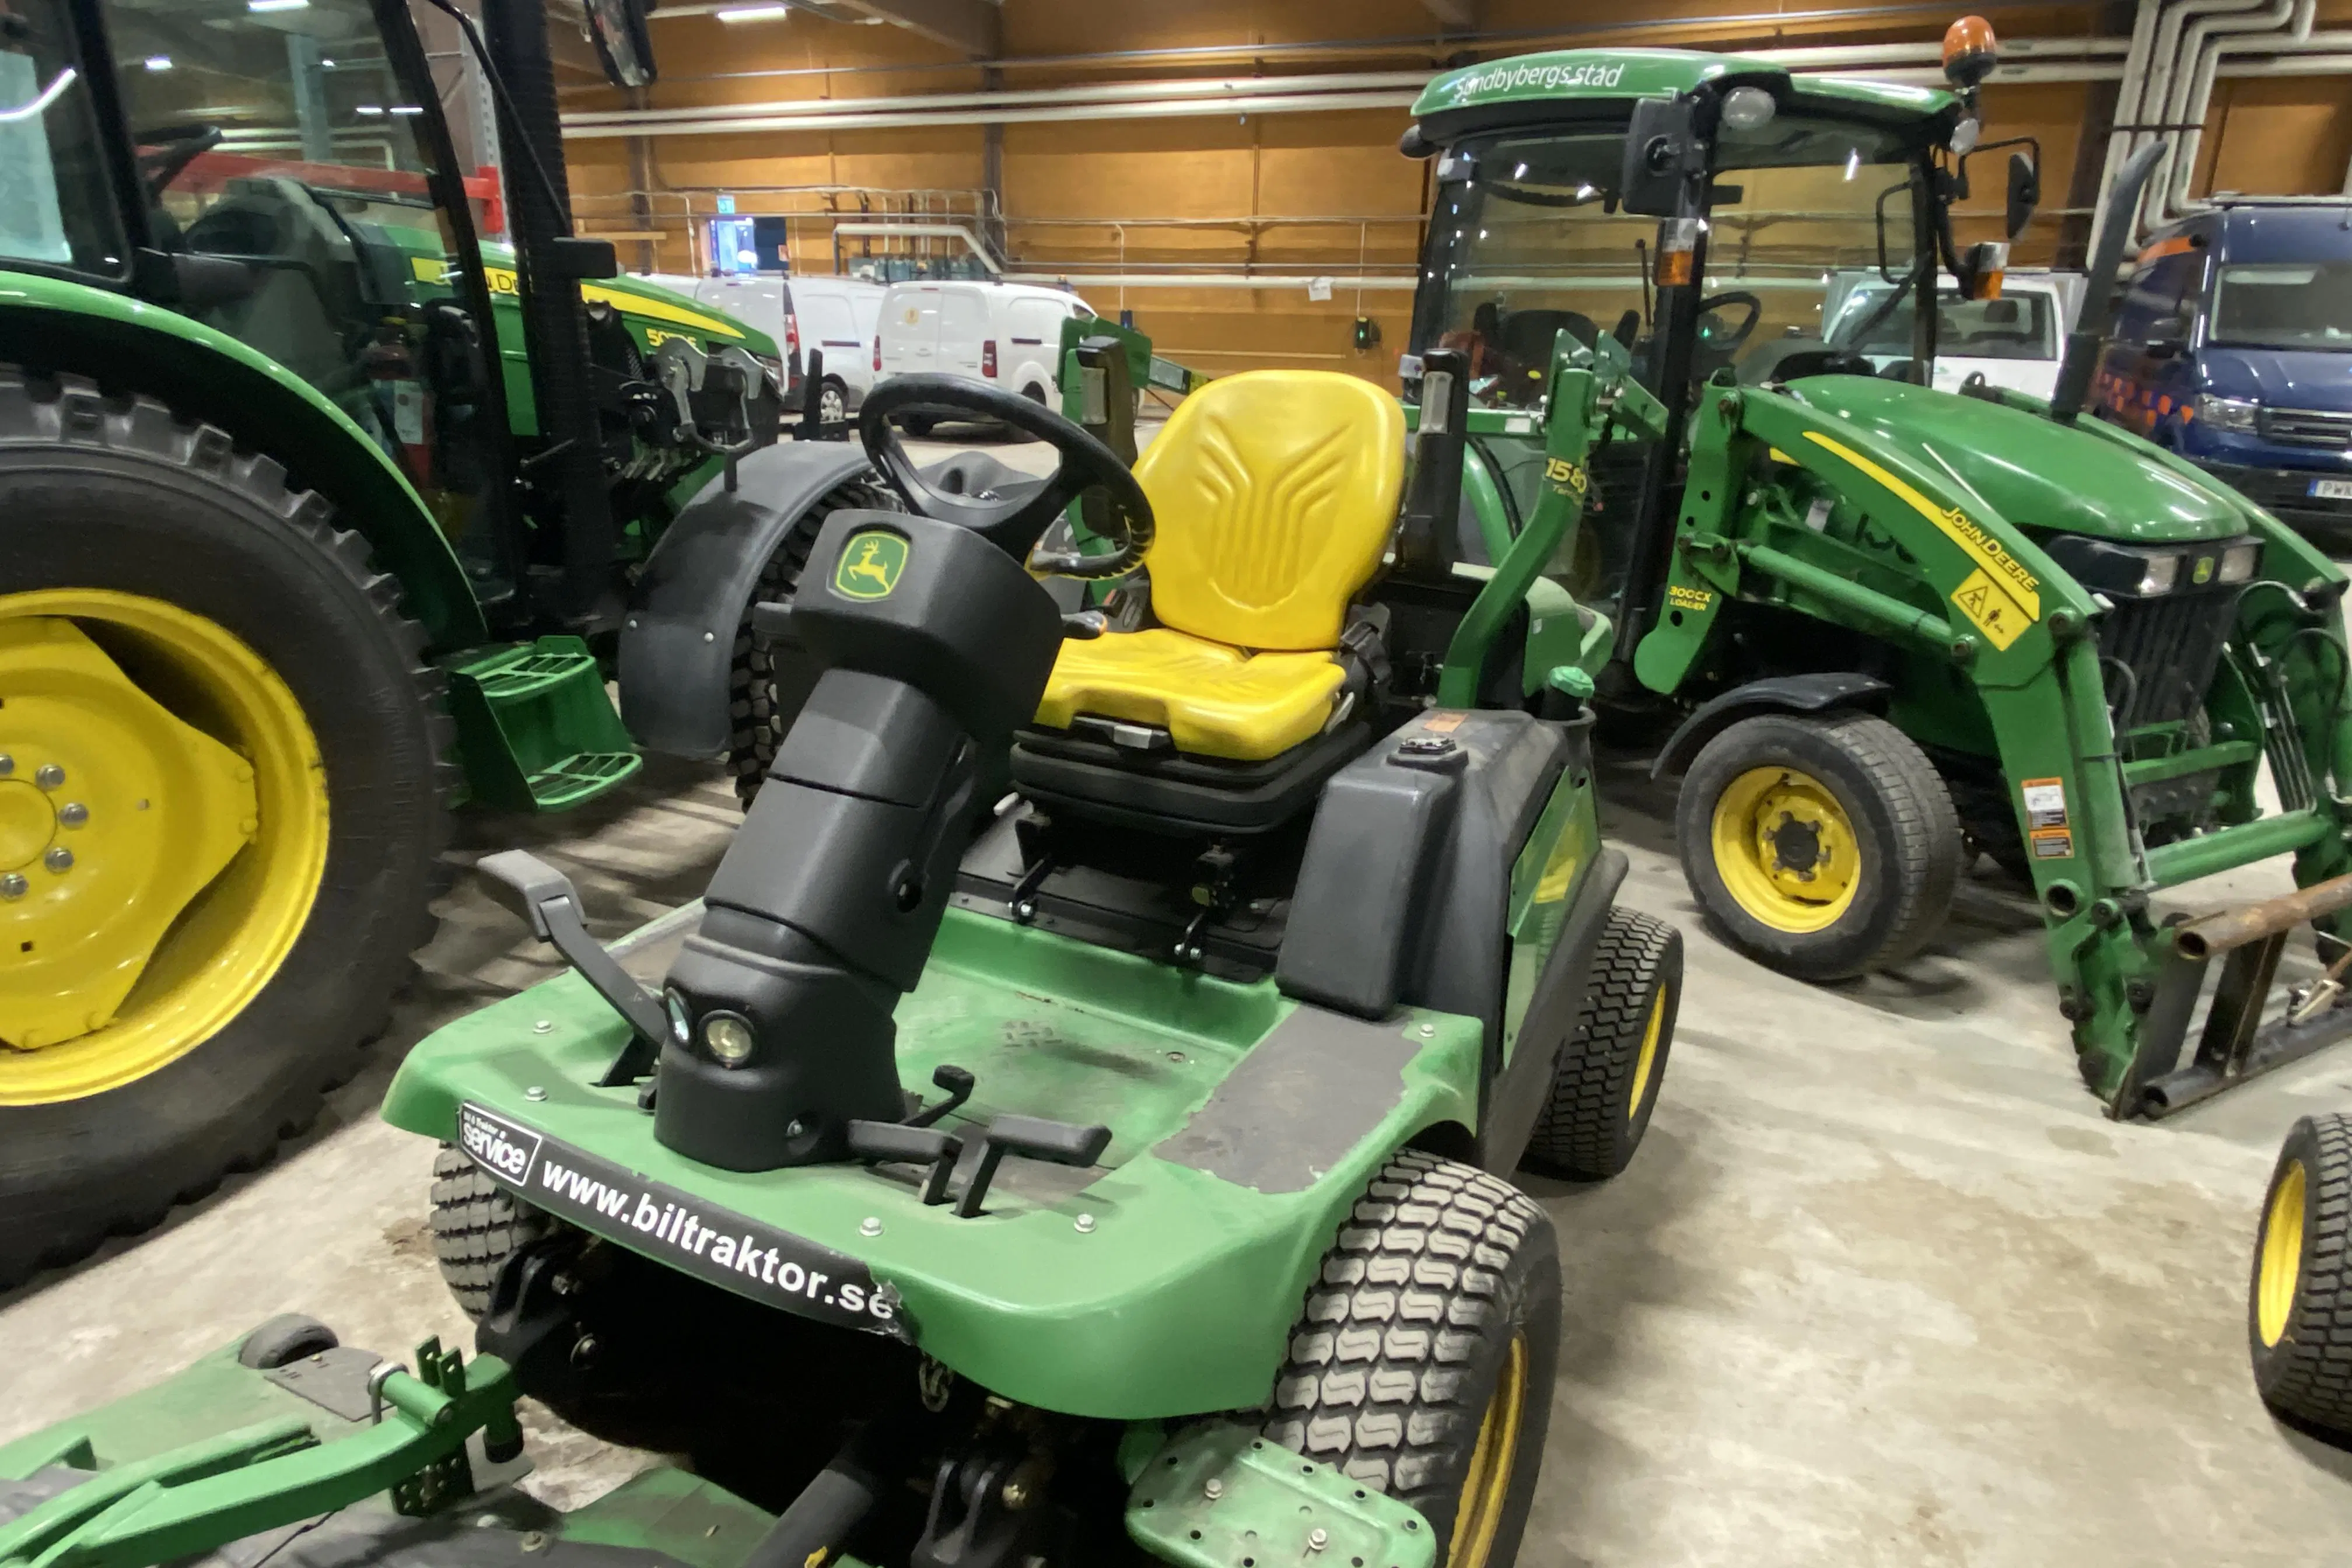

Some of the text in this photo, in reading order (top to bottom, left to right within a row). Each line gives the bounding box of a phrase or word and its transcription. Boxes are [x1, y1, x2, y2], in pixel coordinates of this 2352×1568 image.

[1454, 62, 1626, 98] Sundbybergs stad
[1941, 507, 2040, 593] JOHN DEERE
[1669, 585, 1712, 603] 300CX
[1670, 597, 1707, 611] LOADER
[463, 1122, 526, 1174] service
[542, 1160, 893, 1320] www.biltraktor.se
